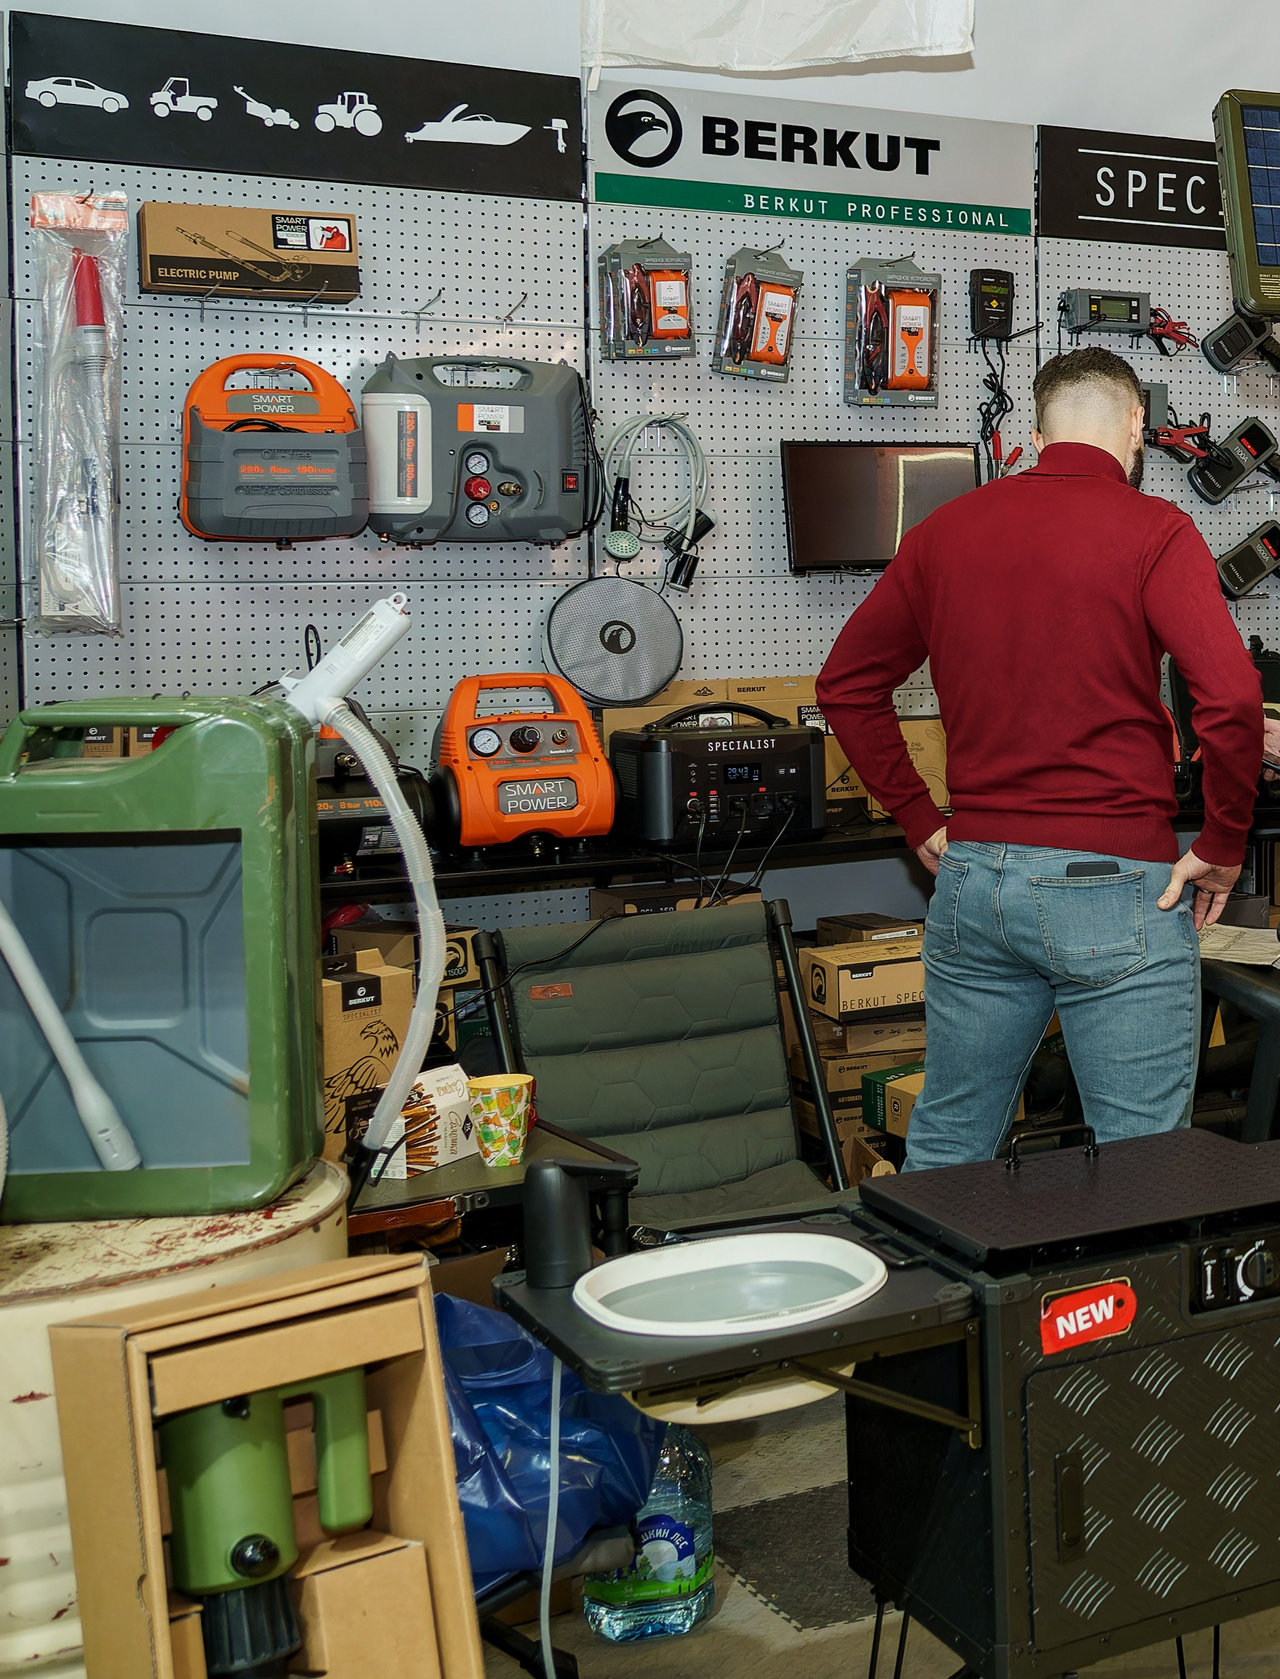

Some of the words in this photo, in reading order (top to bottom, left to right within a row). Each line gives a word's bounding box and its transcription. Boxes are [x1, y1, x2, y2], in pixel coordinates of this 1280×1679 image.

[702, 115, 941, 176] BERKUT
[1094, 166, 1208, 214] SPEC
[743, 193, 828, 216] BERKUT
[847, 202, 1009, 229] PROFESSIONAL
[275, 216, 307, 225] SMART
[275, 224, 308, 233] POWER
[157, 267, 208, 280] ELECTRIC
[208, 270, 240, 281] PUMP
[767, 300, 788, 308] SMART
[252, 395, 293, 403] SMART
[253, 404, 295, 413] POWER
[478, 406, 505, 414] SMART
[708, 738, 777, 752] SPECIALIST
[505, 780, 565, 797] SMART
[831, 785, 859, 793] BERKUT
[507, 796, 568, 813] POWER
[447, 966, 467, 977] 1500A
[348, 995, 375, 1006] BERKUT
[841, 996, 887, 1011] BERKUT
[342, 1009, 382, 1021] SPECIALIST
[1055, 1295, 1115, 1341] NEW
[669, 1531, 689, 1550] ЛЕС
